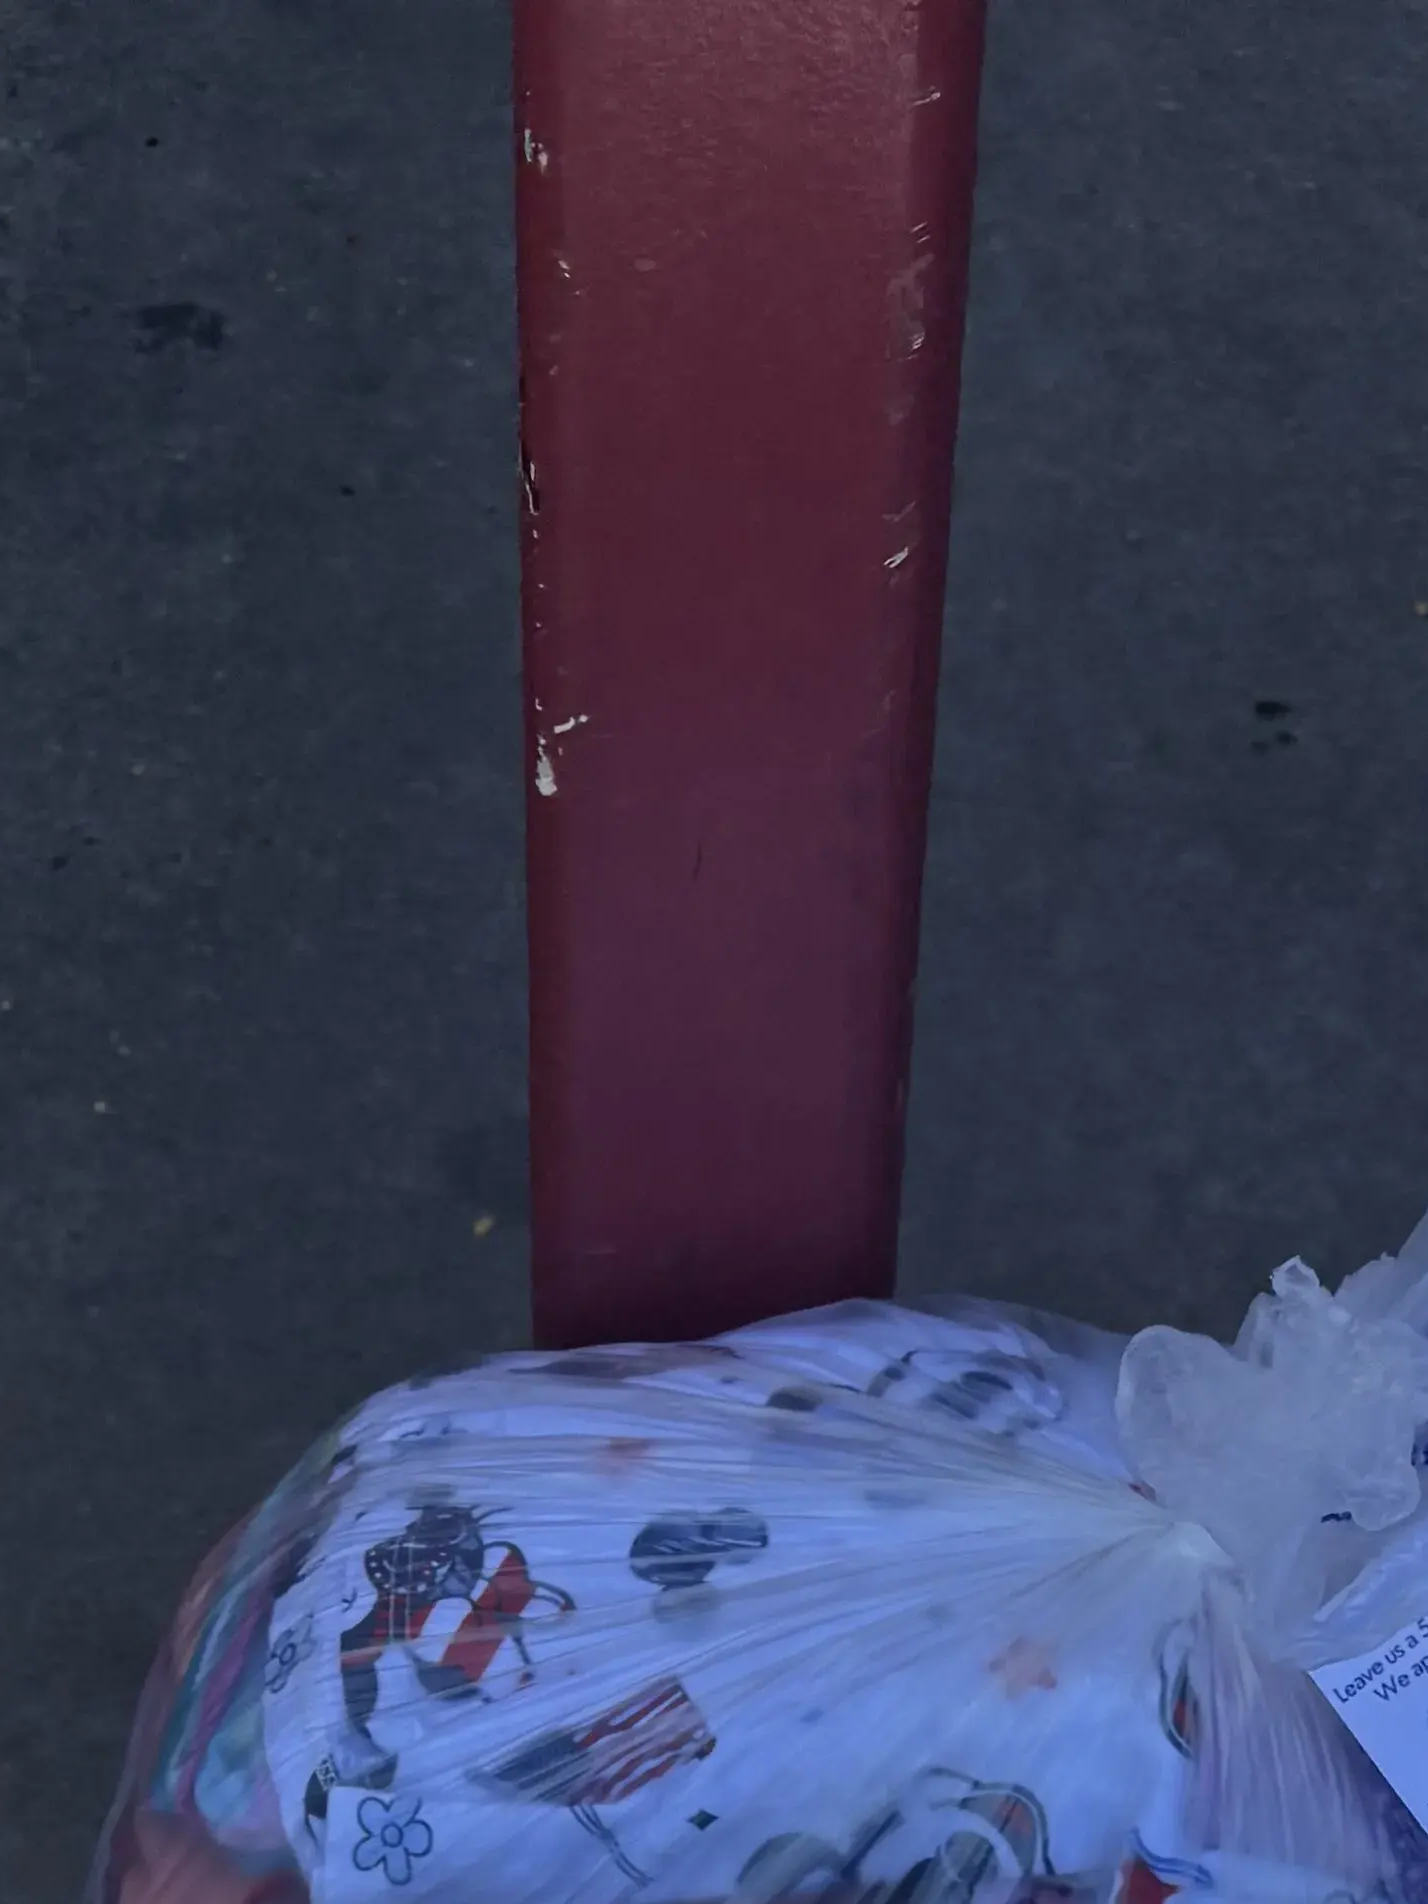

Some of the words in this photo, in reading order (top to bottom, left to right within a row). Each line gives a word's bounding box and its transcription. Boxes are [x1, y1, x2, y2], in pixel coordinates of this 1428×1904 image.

[1331, 1660, 1384, 1704] Leave
[1383, 1643, 1406, 1665] us
[1404, 1633, 1419, 1649] a
[1371, 1673, 1411, 1701] We
